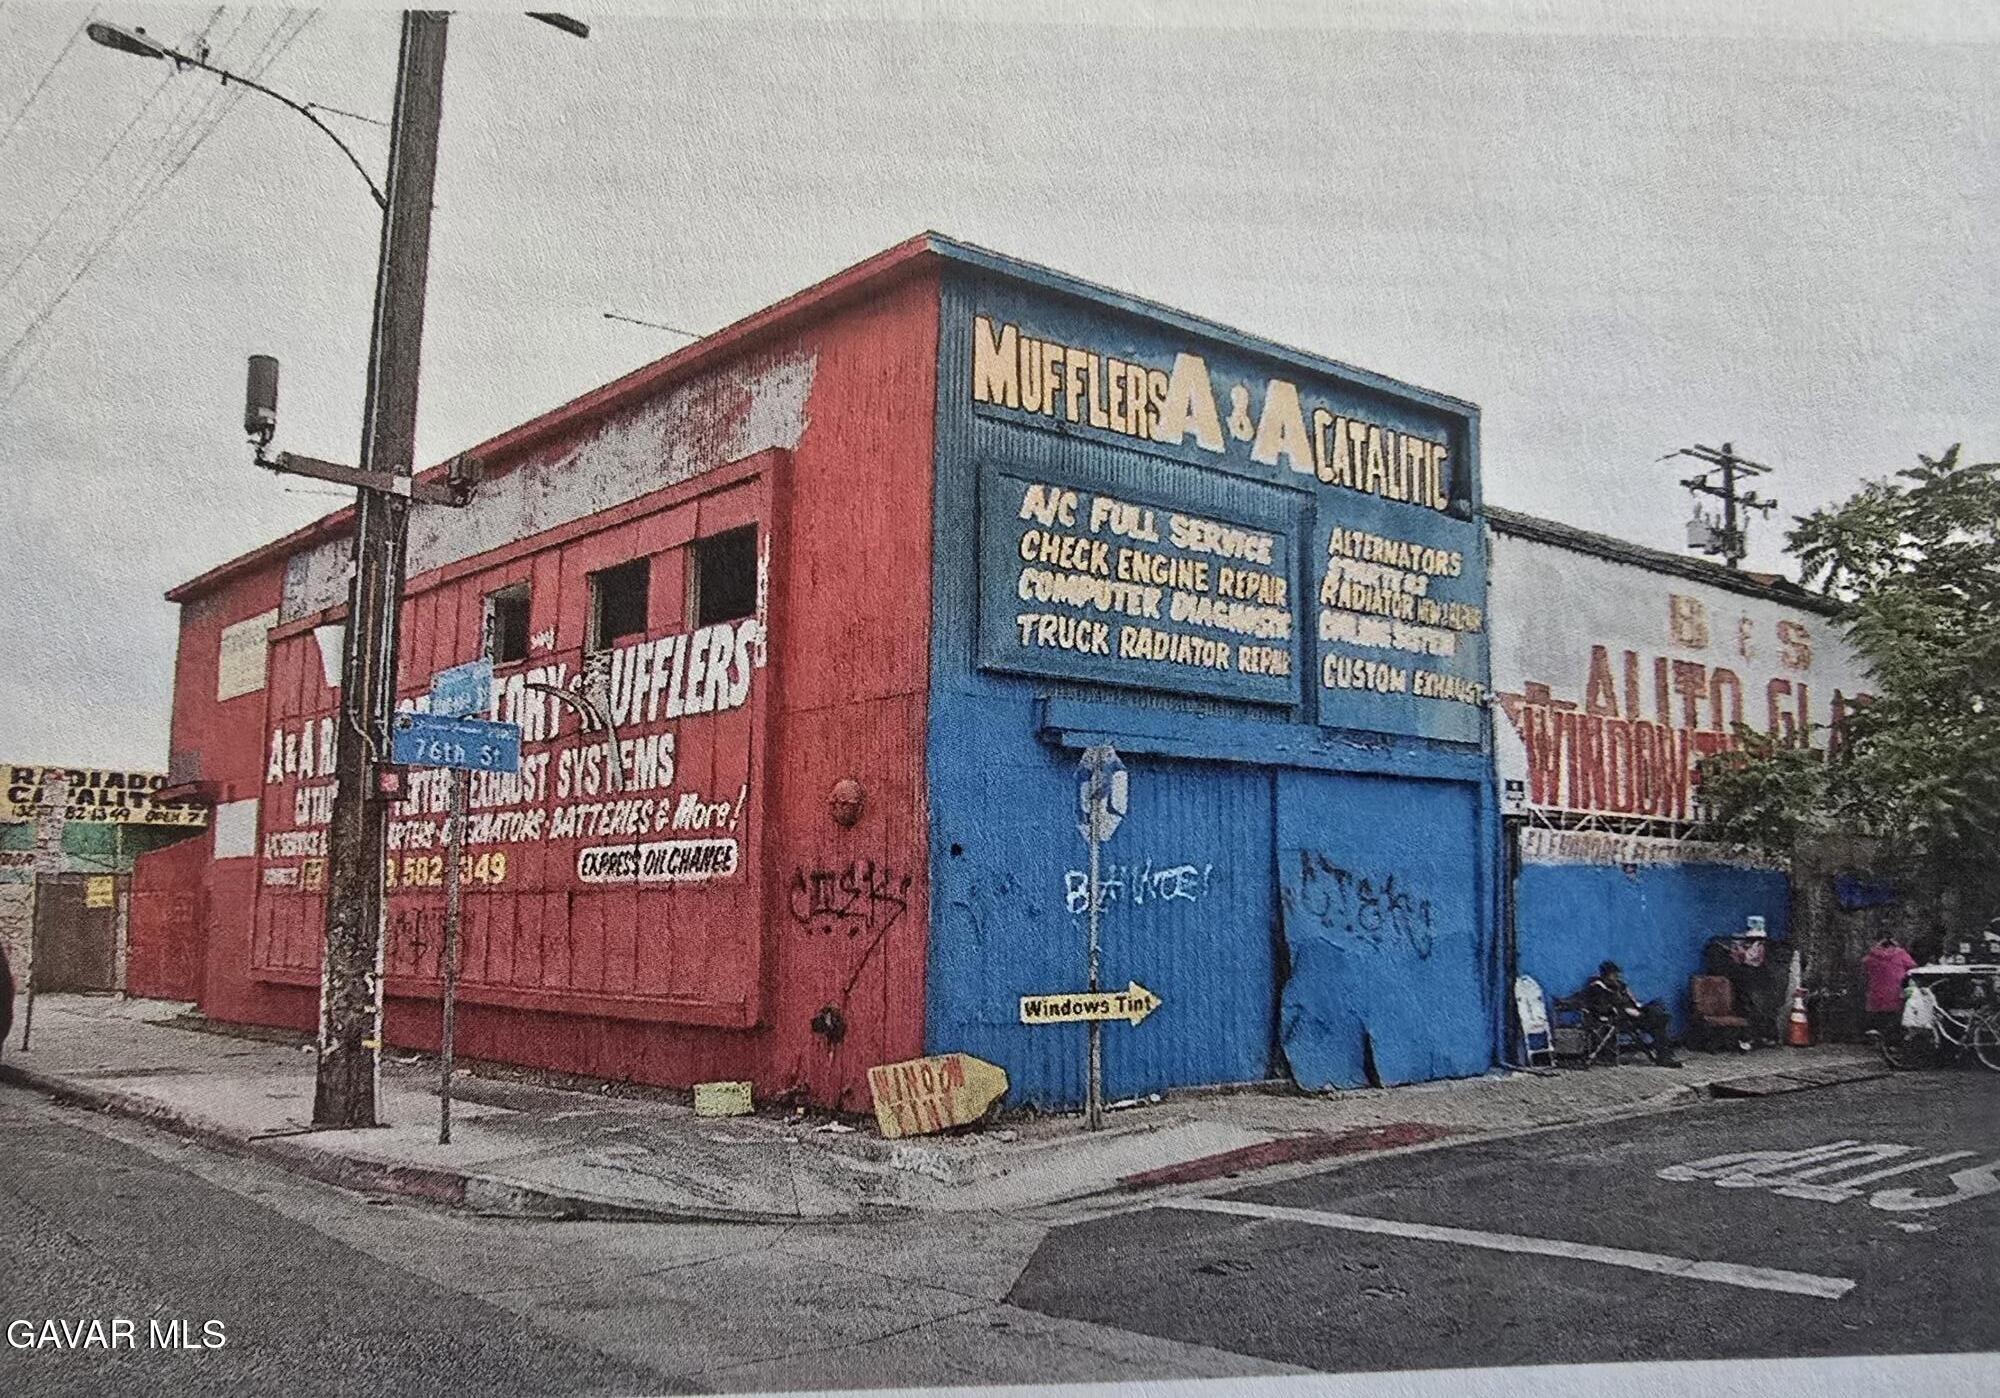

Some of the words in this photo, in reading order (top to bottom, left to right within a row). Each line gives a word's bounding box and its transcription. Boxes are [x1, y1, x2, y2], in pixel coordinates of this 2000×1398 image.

[973, 314, 1169, 441] MUFFLERS
[1160, 353, 1225, 453] A
[1227, 383, 1256, 441] &
[1251, 379, 1315, 475] A
[1312, 407, 1449, 511] CATALITIC
[1020, 484, 1077, 527] A/C
[1090, 498, 1159, 543] FULL
[1170, 513, 1274, 566] SERVICE
[1328, 526, 1464, 578] ALTERNATORS
[1018, 566, 1161, 620] COMPUTER
[1020, 529, 1110, 576] CHECK
[1116, 548, 1209, 592] ENGINE
[1217, 566, 1288, 608] REPAIR
[1016, 612, 1110, 656] TRUCK
[1118, 625, 1231, 671] RADIATOR
[1669, 593, 1709, 649] B
[1776, 619, 1812, 671] S
[1323, 653, 1407, 694] CUSTOM
[1412, 669, 1488, 706] EXHAUST
[415, 737, 466, 764] 76th
[480, 744, 501, 766] St
[556, 731, 675, 800] SYSTEMS
[1522, 705, 1691, 820] WINDOW
[549, 799, 655, 839] BATTERIES
[671, 784, 747, 833] More!
[581, 850, 641, 878] EXPRESS
[667, 845, 734, 874] CHANGE
[1024, 1000, 1110, 1017] Windows
[1115, 996, 1151, 1013] Tint
